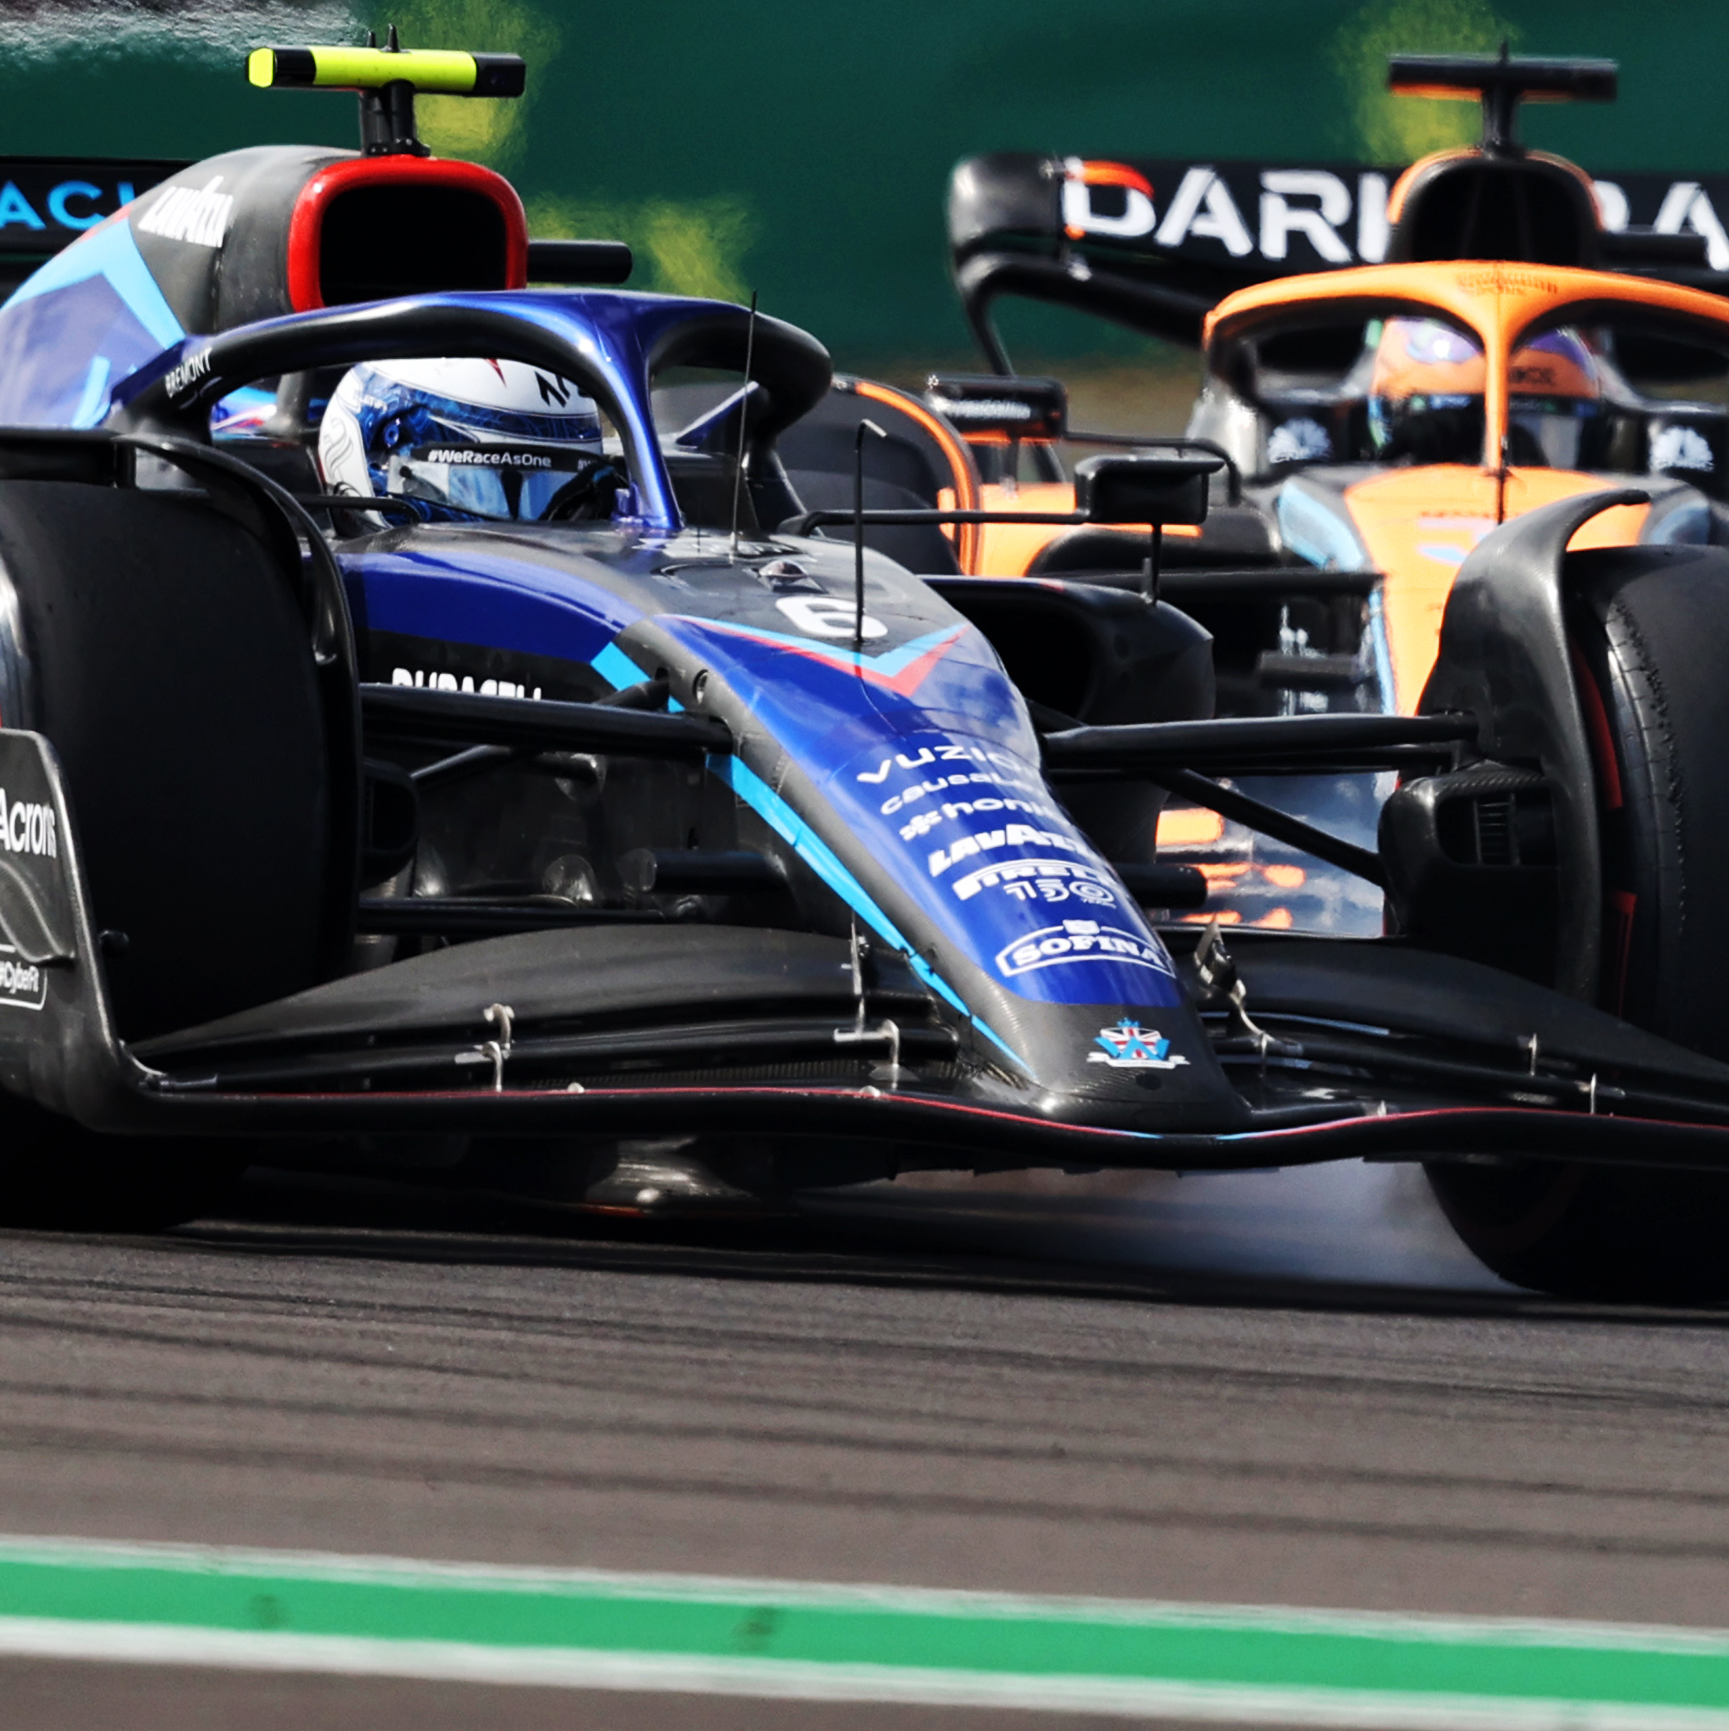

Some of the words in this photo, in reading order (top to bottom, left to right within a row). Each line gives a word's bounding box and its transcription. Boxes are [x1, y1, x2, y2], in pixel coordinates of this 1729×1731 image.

[427, 449, 552, 468] #WeRaceAsOne
[775, 595, 889, 638] 6
[1011, 934, 1167, 969] SOFINA
